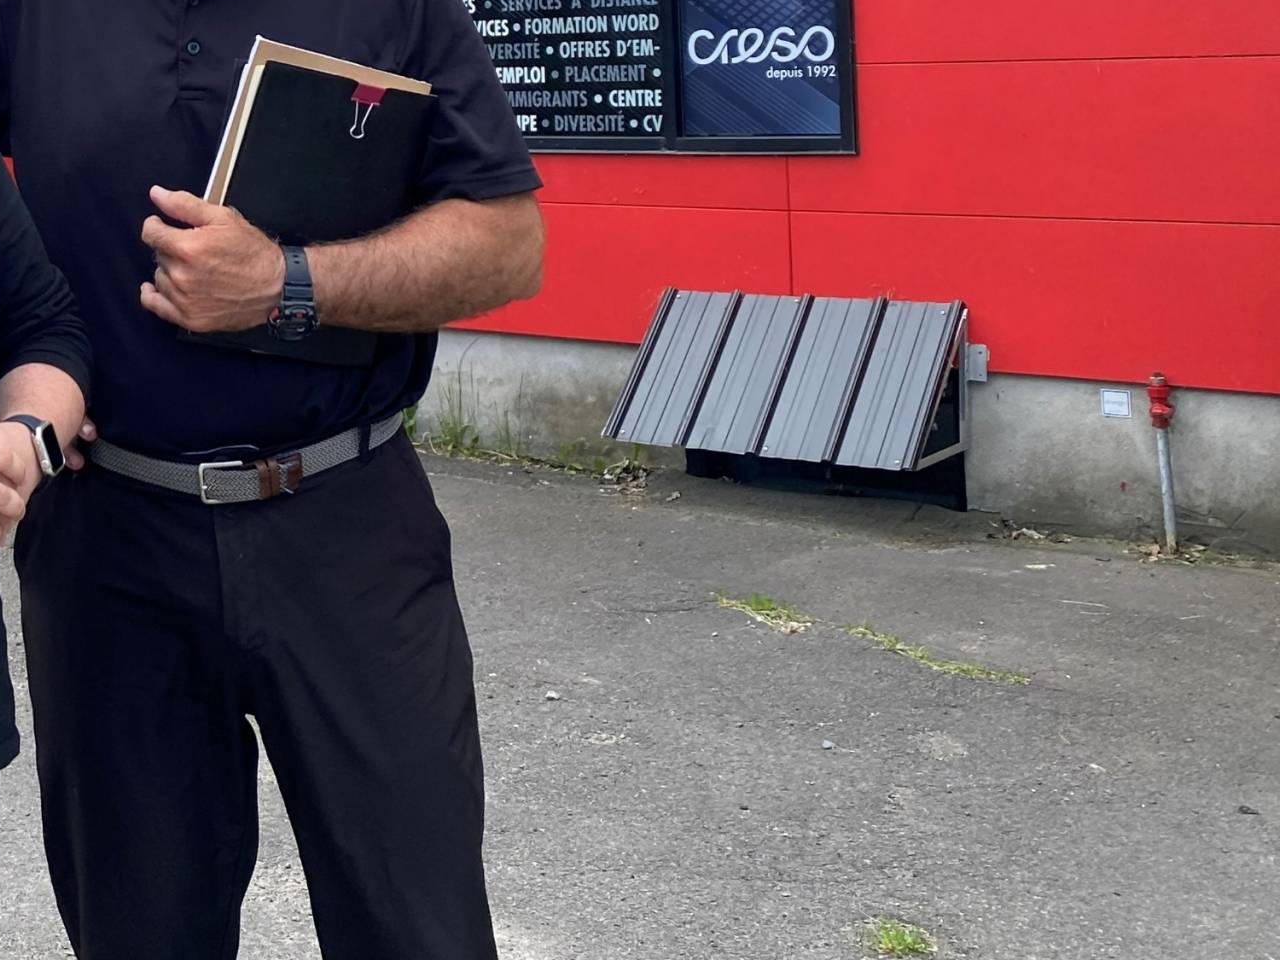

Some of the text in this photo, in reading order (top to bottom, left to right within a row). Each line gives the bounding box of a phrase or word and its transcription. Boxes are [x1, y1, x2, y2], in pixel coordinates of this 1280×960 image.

[473, 13, 660, 37] VICES FORMATION WORD
[487, 38, 541, 59] VERSITÉ
[559, 40, 610, 59] OFFRES
[564, 64, 647, 83] PLACEMENT
[766, 65, 837, 81] depuis 1992
[506, 89, 663, 108] MMIGRANTS CENTRE
[554, 110, 626, 132] DIVERSITÉ
[642, 114, 664, 132] CV
